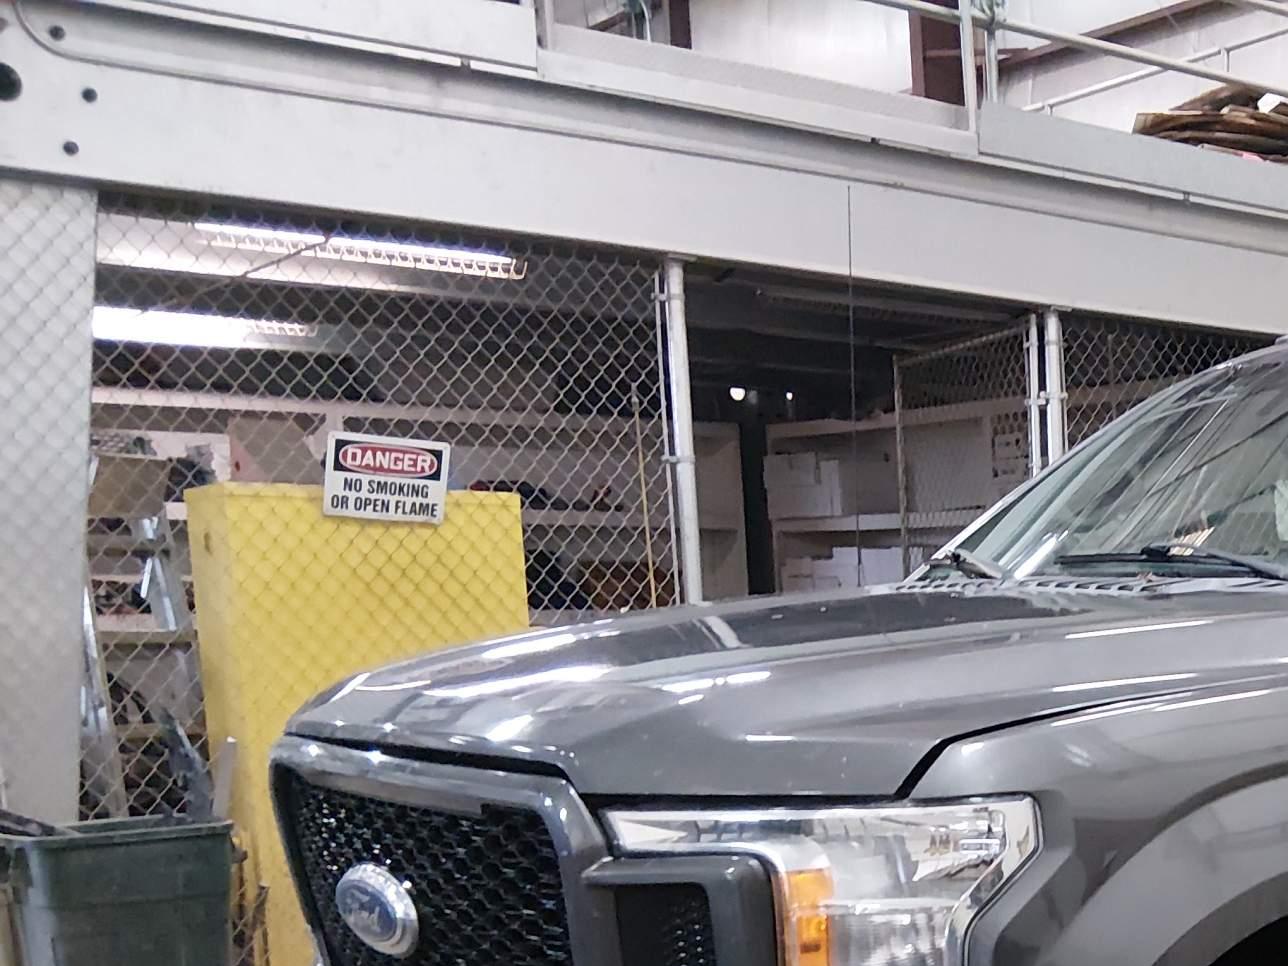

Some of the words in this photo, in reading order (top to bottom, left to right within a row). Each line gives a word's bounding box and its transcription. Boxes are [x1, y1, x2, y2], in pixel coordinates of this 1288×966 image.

[346, 448, 431, 473] DANGER
[343, 477, 362, 493] NO
[367, 480, 429, 499] SMOKING
[331, 494, 349, 509] OR
[354, 496, 390, 513] OPEN
[394, 500, 438, 518] FLAME
